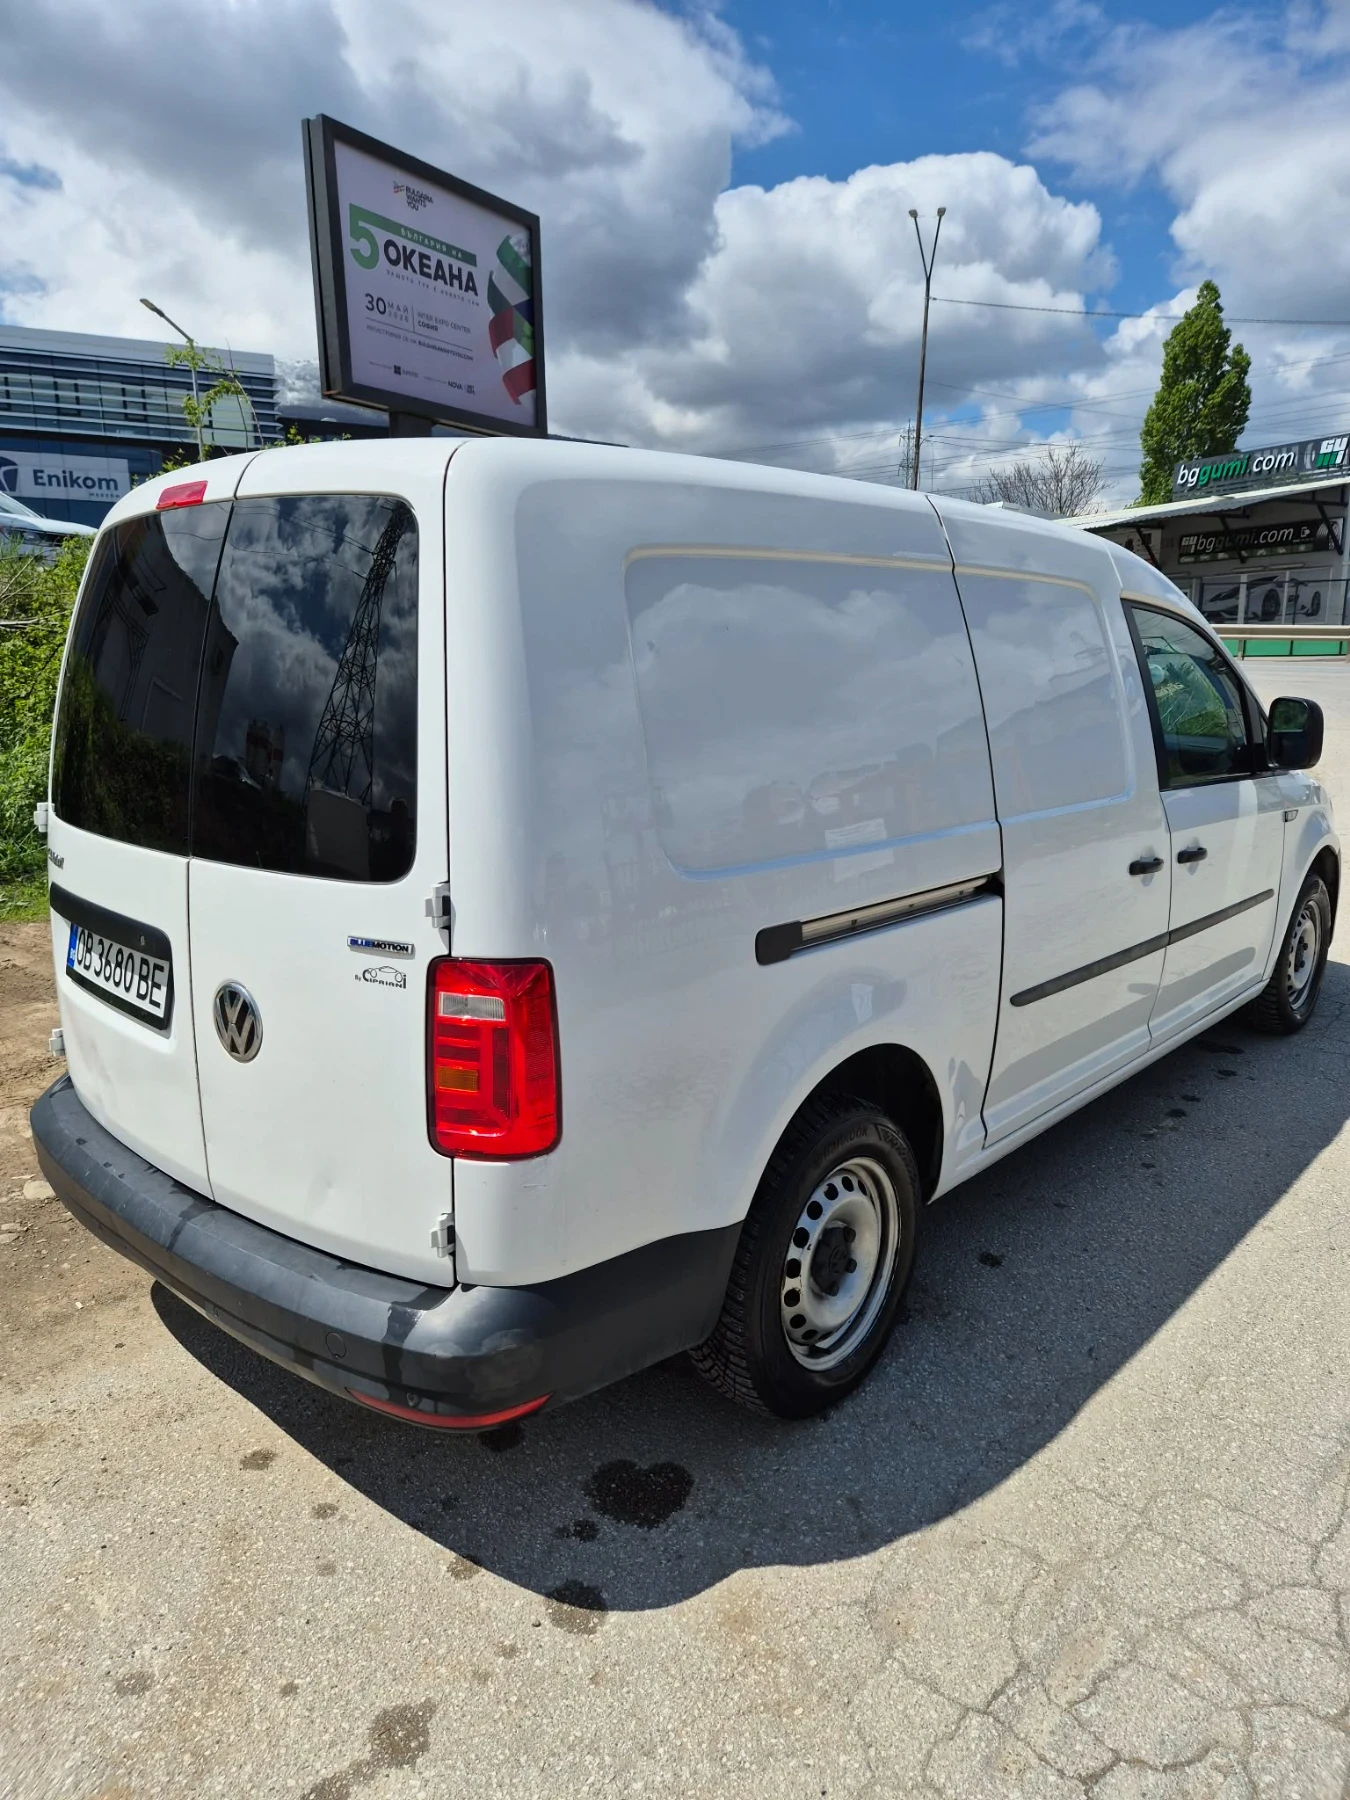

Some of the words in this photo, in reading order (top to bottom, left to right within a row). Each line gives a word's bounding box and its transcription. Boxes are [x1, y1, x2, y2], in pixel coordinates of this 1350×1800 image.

[405, 185, 434, 205] BULGARIA
[406, 194, 427, 208] WANTS
[407, 202, 419, 211] YOU
[349, 202, 380, 270] 5
[384, 239, 478, 296] ОКЕАНА
[400, 227, 447, 254] БЪЛГАРИЯ
[451, 249, 463, 259] НА
[365, 293, 387, 315] 30
[387, 301, 409, 314] МАЙ
[417, 320, 439, 332] СОФИЯ
[434, 316, 450, 328] EXPO
[450, 321, 472, 334] CENTER
[1177, 451, 1294, 486] bggumi.com
[32, 469, 119, 491] Enikom
[93, 937, 135, 993] 3680
[136, 957, 165, 1009] BE
